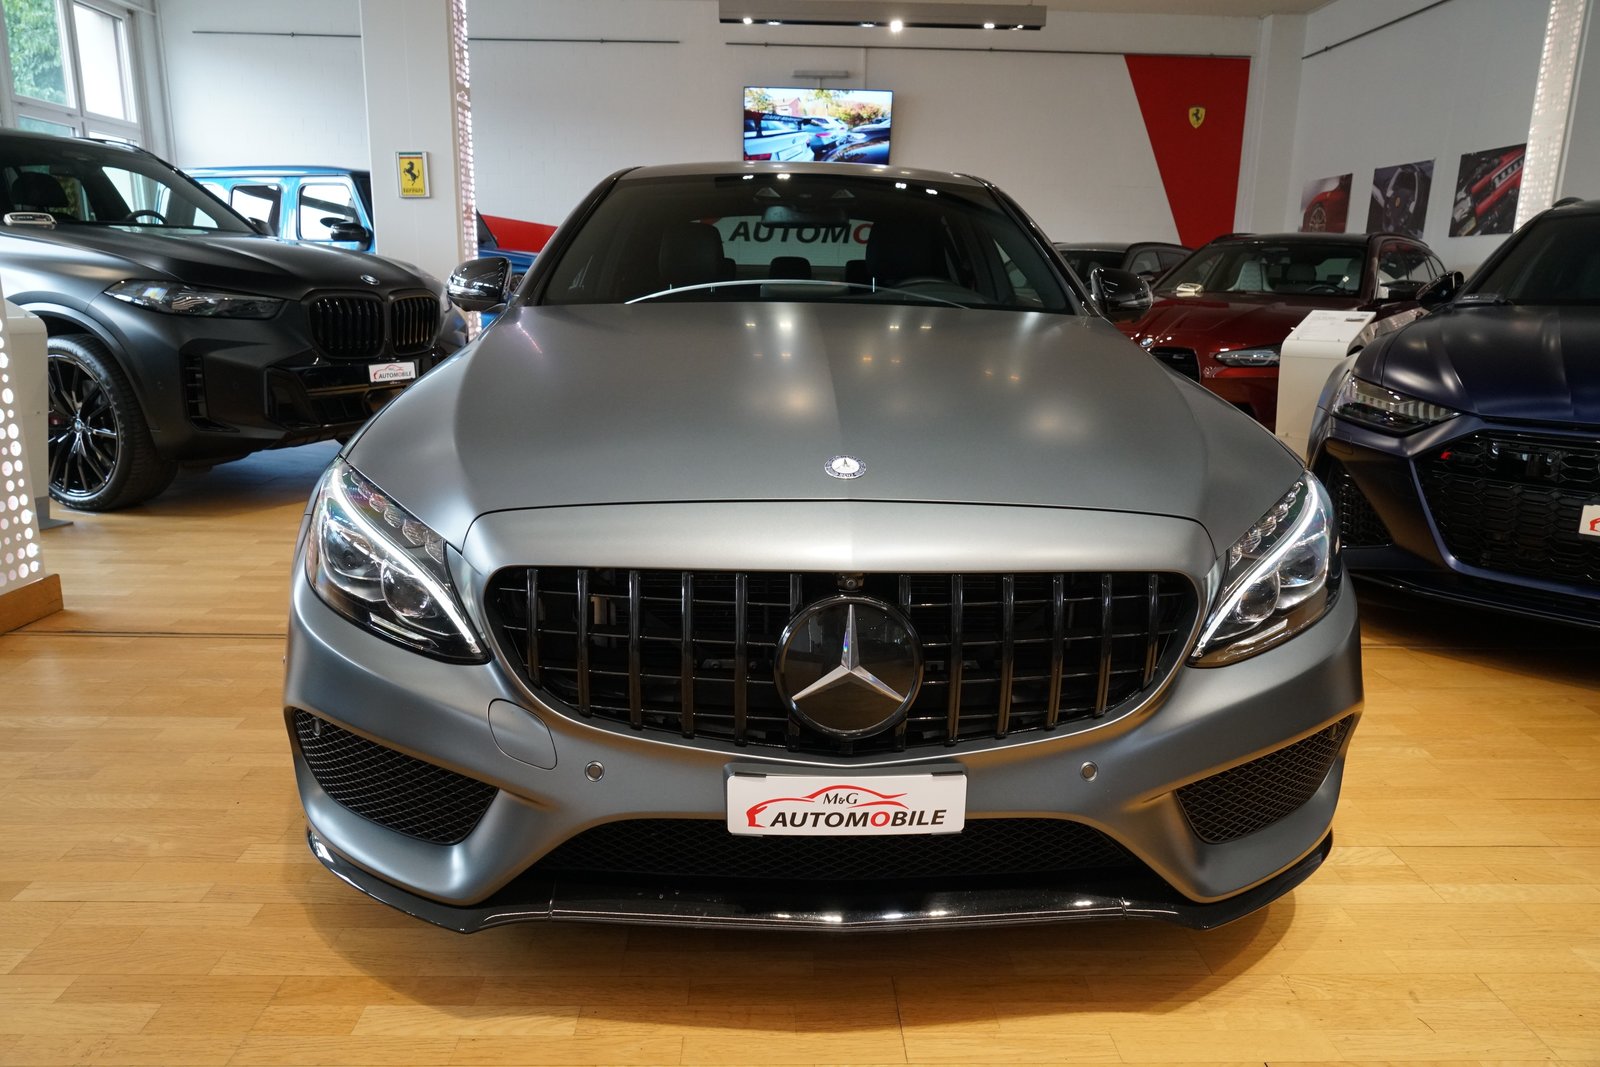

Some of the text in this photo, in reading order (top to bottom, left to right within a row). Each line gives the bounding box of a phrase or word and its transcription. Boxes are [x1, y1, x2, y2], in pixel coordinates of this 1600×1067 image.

[379, 371, 412, 379] AUTOMOBILE
[823, 793, 859, 805] M&G
[769, 809, 947, 828] AUTOMOBILE
